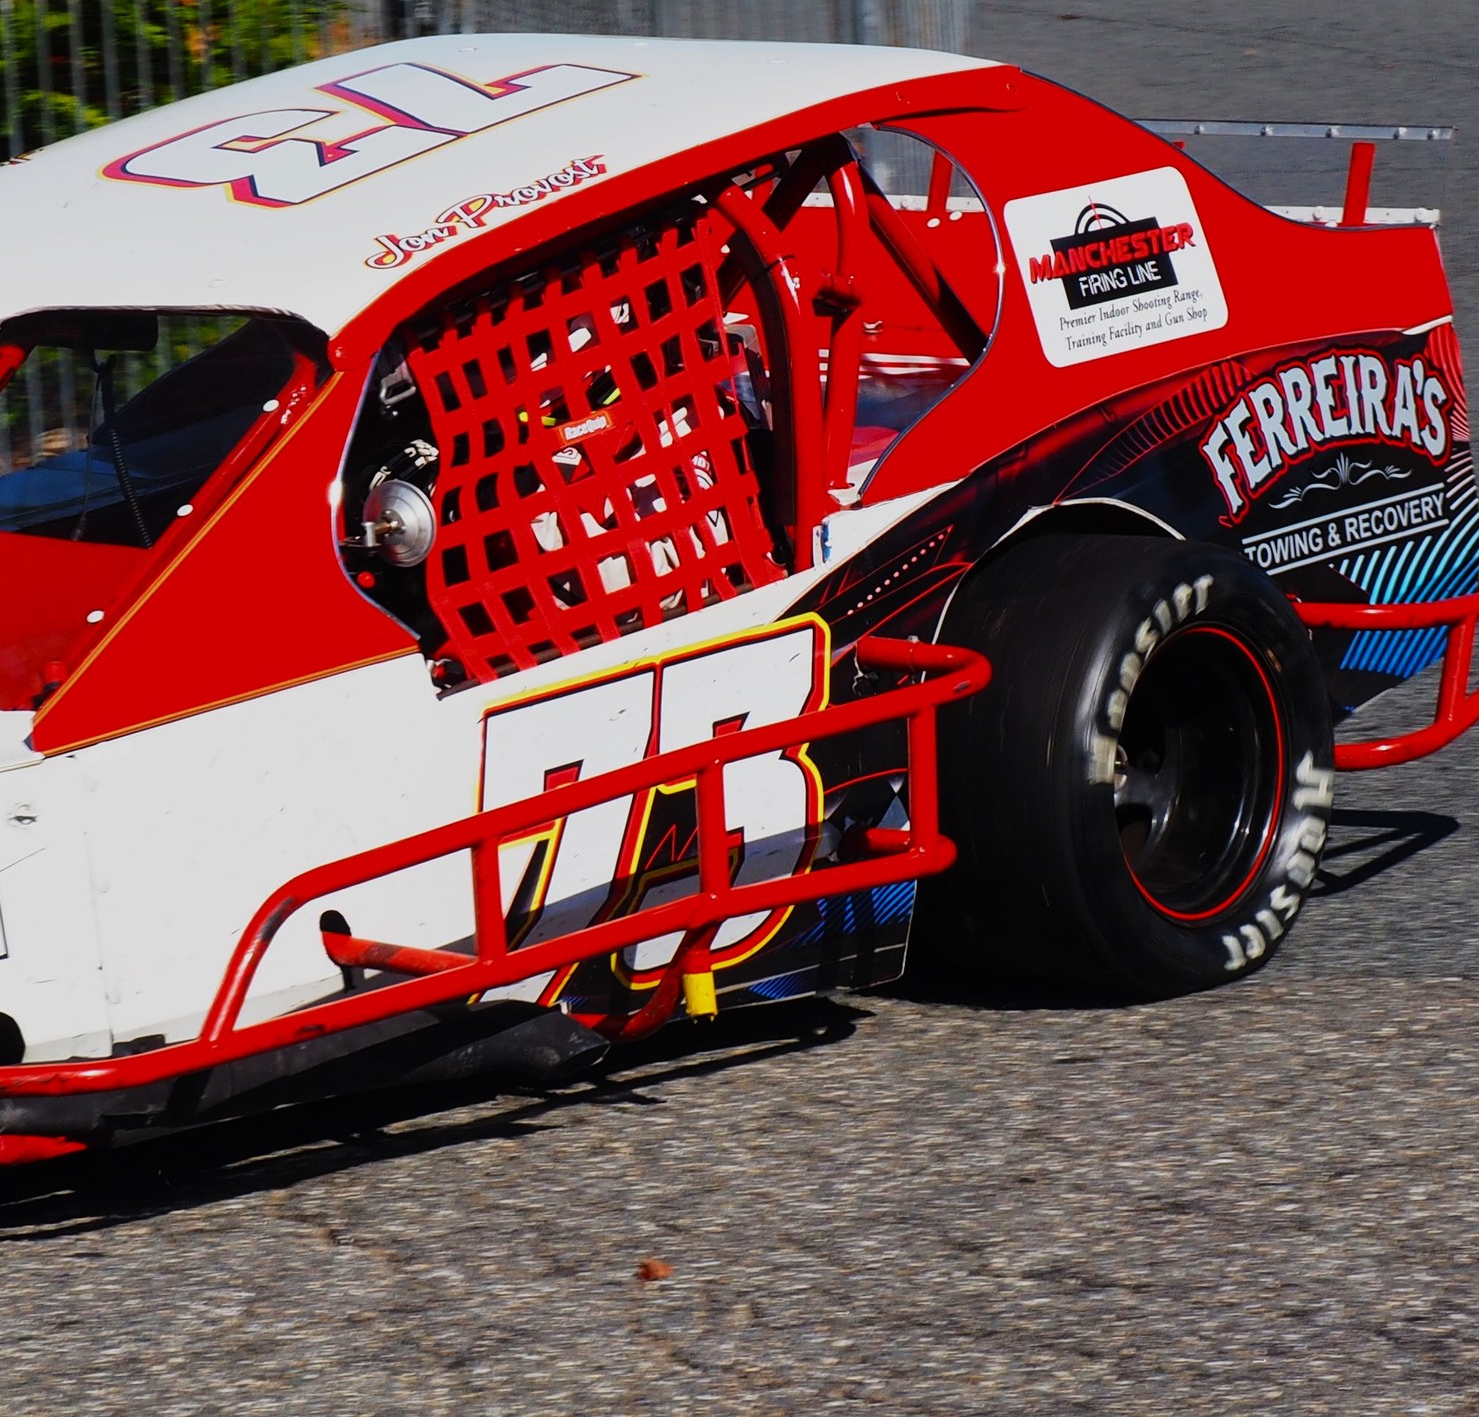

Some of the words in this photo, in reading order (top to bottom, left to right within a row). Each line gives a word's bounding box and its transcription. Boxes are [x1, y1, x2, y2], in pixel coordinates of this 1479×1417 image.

[97, 60, 647, 208] 73
[364, 233, 458, 269] Jon
[435, 154, 607, 229] Provost
[1029, 222, 1196, 285] MANCHESTER
[1078, 268, 1127, 298] FIRING
[1127, 260, 1162, 286] LINE
[1059, 313, 1097, 332] Premier
[1099, 304, 1131, 323] Indoor
[1132, 293, 1172, 314] Shooting
[1065, 330, 1108, 352] Training
[1109, 320, 1144, 341] Facility
[1145, 313, 1163, 332] and
[1164, 312, 1186, 328] Gun
[1186, 306, 1209, 323] Shop
[1201, 353, 1449, 516] FERREIRA'S
[1244, 527, 1323, 570] TOWING
[1327, 521, 1342, 548] &
[1344, 491, 1446, 543] RECOVERY
[469, 610, 832, 1006] 73
